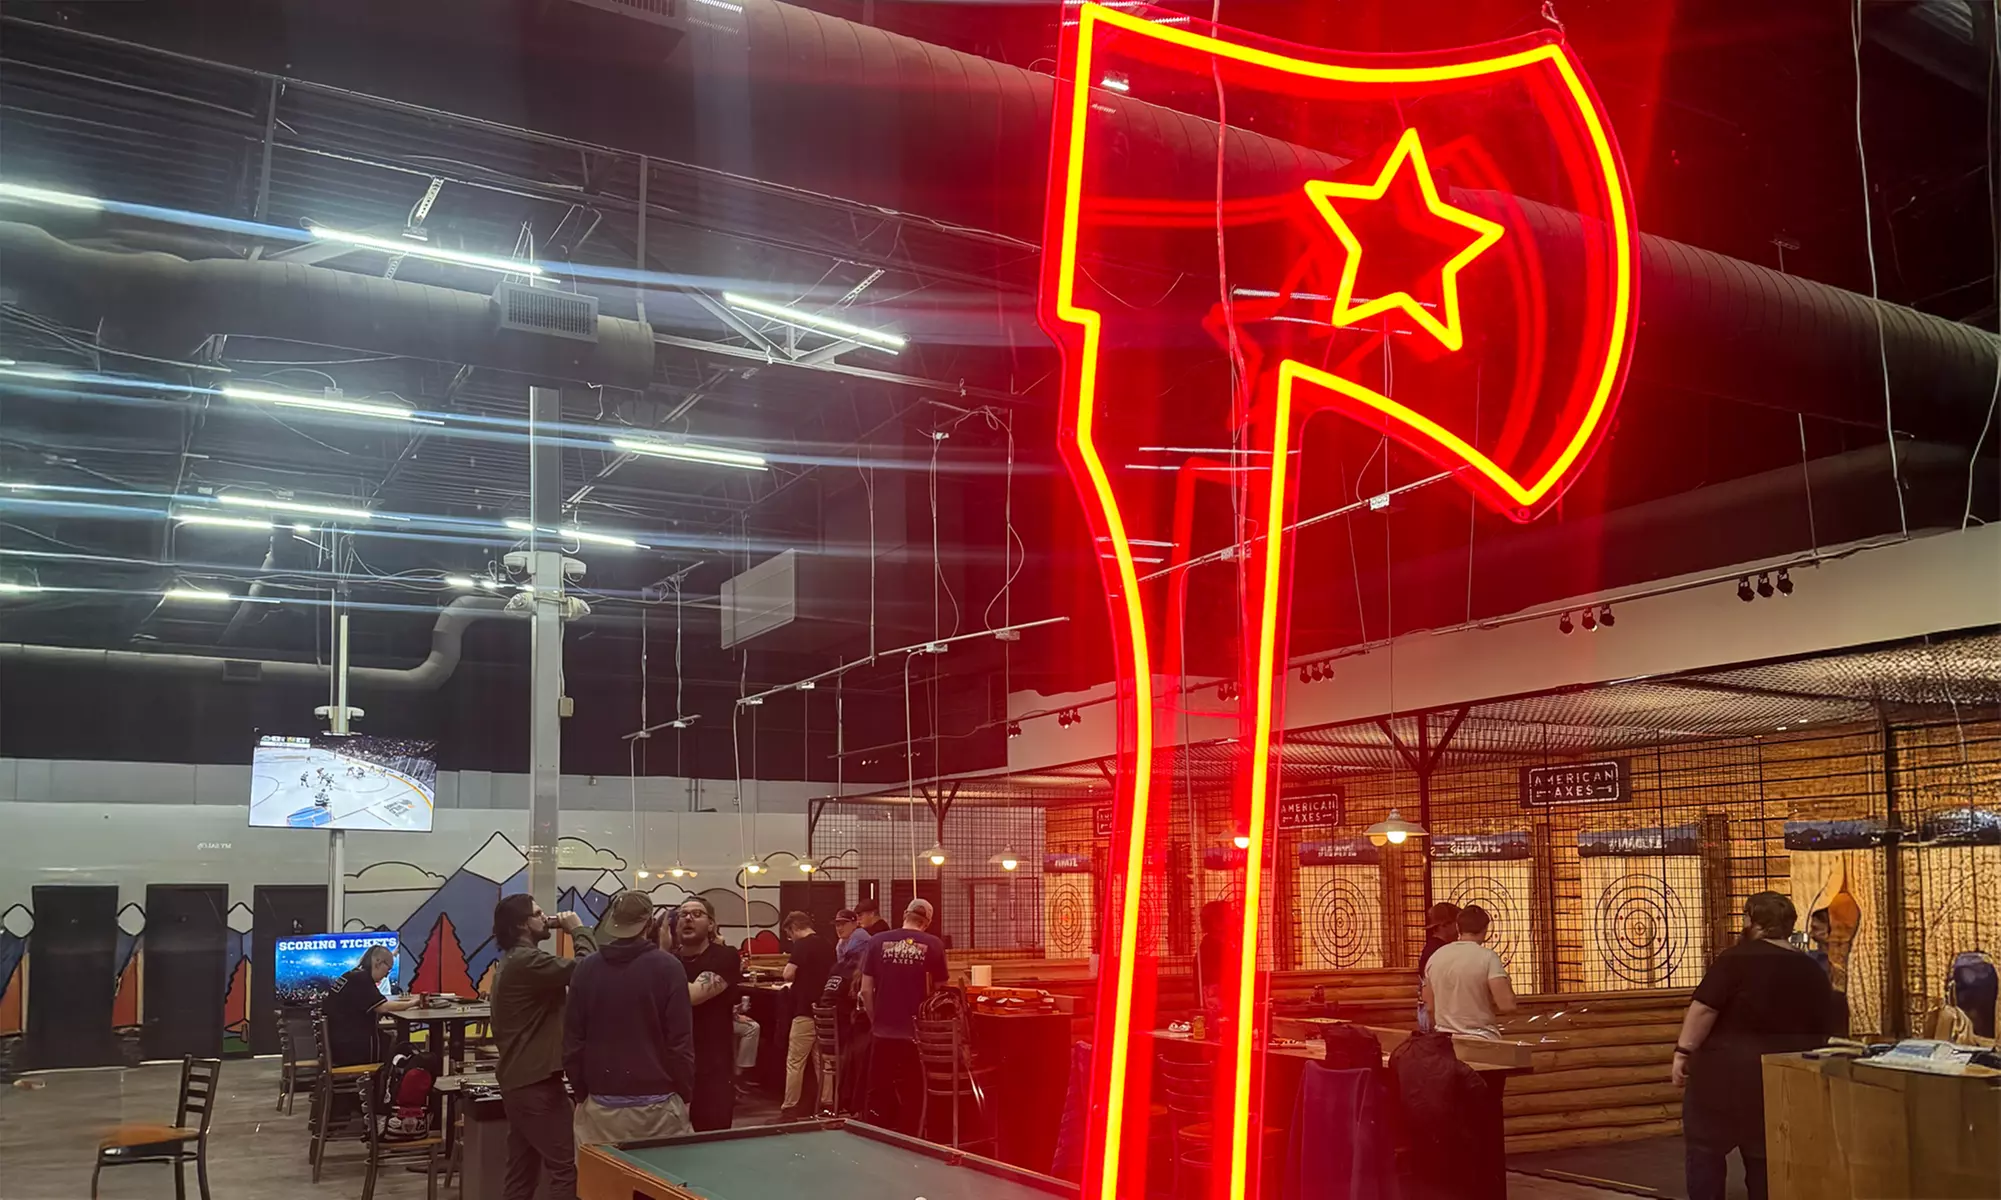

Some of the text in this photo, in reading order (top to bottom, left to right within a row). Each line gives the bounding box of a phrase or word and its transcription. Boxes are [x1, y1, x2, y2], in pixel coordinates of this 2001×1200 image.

[1534, 769, 1614, 787] AMERICAN
[1554, 785, 1594, 798] AXES
[1281, 800, 1336, 814] AMERICAN
[1294, 812, 1322, 823] AXES
[279, 938, 397, 951] SCORING TICKETS
